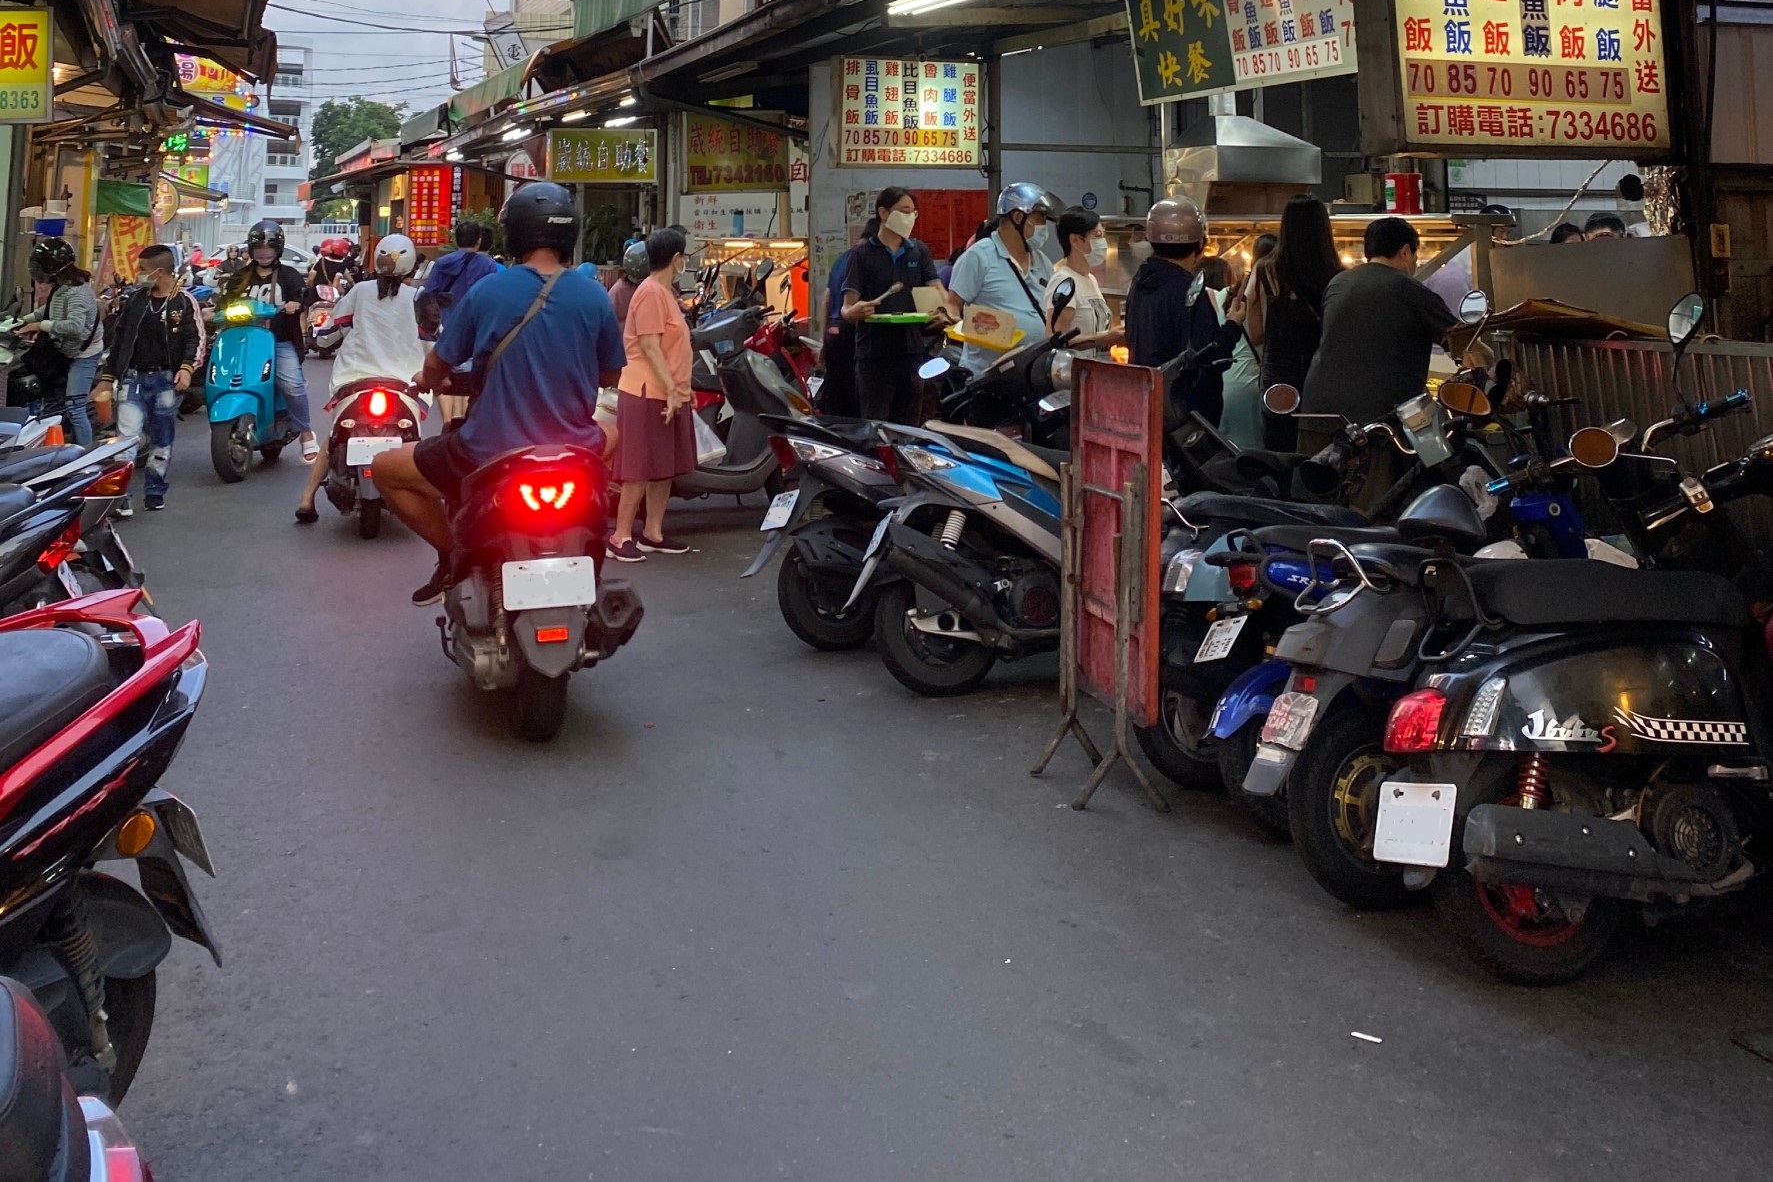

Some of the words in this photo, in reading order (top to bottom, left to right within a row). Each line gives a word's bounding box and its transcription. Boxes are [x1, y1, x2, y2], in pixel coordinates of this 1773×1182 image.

[0, 23, 38, 69] 飯
[1157, 41, 1212, 89] 快餐
[1236, 58, 1248, 76] 70
[1252, 54, 1266, 74] 85
[1268, 52, 1280, 72] 70
[1287, 49, 1300, 68] 90
[1305, 45, 1319, 65] 65
[1325, 40, 1339, 62] 75
[845, 60, 860, 125] 排骨飯
[865, 60, 879, 125] 虱目魚飯
[885, 62, 899, 125] 雞翅飯
[902, 63, 919, 130] 比目魚飯
[943, 64, 957, 127] 雞腿飯
[963, 73, 976, 141] 便當外送
[1408, 63, 1435, 93] 70
[1448, 64, 1477, 94] 85
[1487, 67, 1512, 96] 70
[1529, 68, 1552, 97] 90
[1565, 70, 1589, 99] 65
[1599, 71, 1624, 100] 75
[845, 130, 859, 145] 70
[863, 130, 880, 145] 85
[884, 131, 898, 145] 70
[904, 131, 918, 145] 90
[923, 131, 937, 146] 65
[943, 132, 957, 146] 75
[1416, 103, 1657, 142] 訂購電話:7334686
